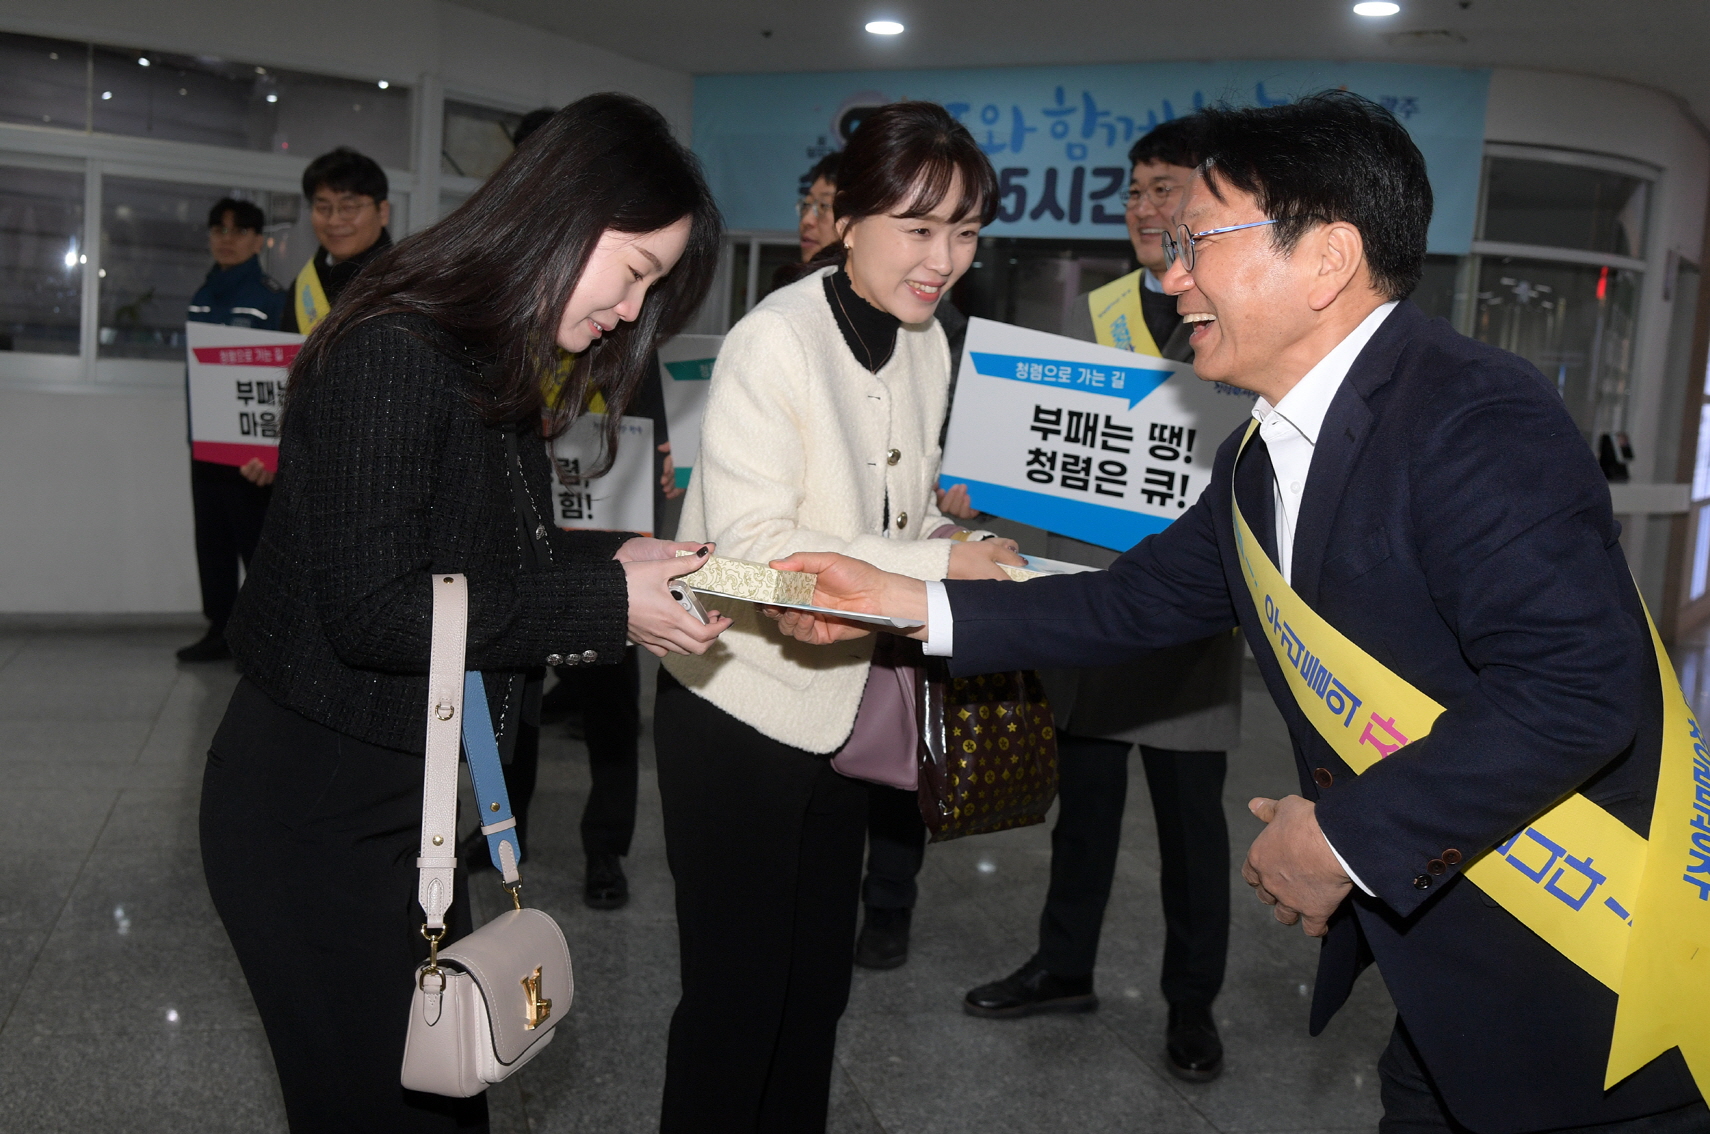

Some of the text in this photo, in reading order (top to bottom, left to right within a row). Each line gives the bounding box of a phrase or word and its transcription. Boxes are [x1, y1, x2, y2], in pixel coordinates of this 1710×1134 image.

[1015, 362, 1126, 389] 청렴으로 가는 길
[1030, 404, 1196, 464] 부패는 땡!
[1026, 447, 1189, 508] 청렴은 큐!
[1265, 594, 1363, 728] 우리들의
[1496, 827, 1633, 927] 니다!
